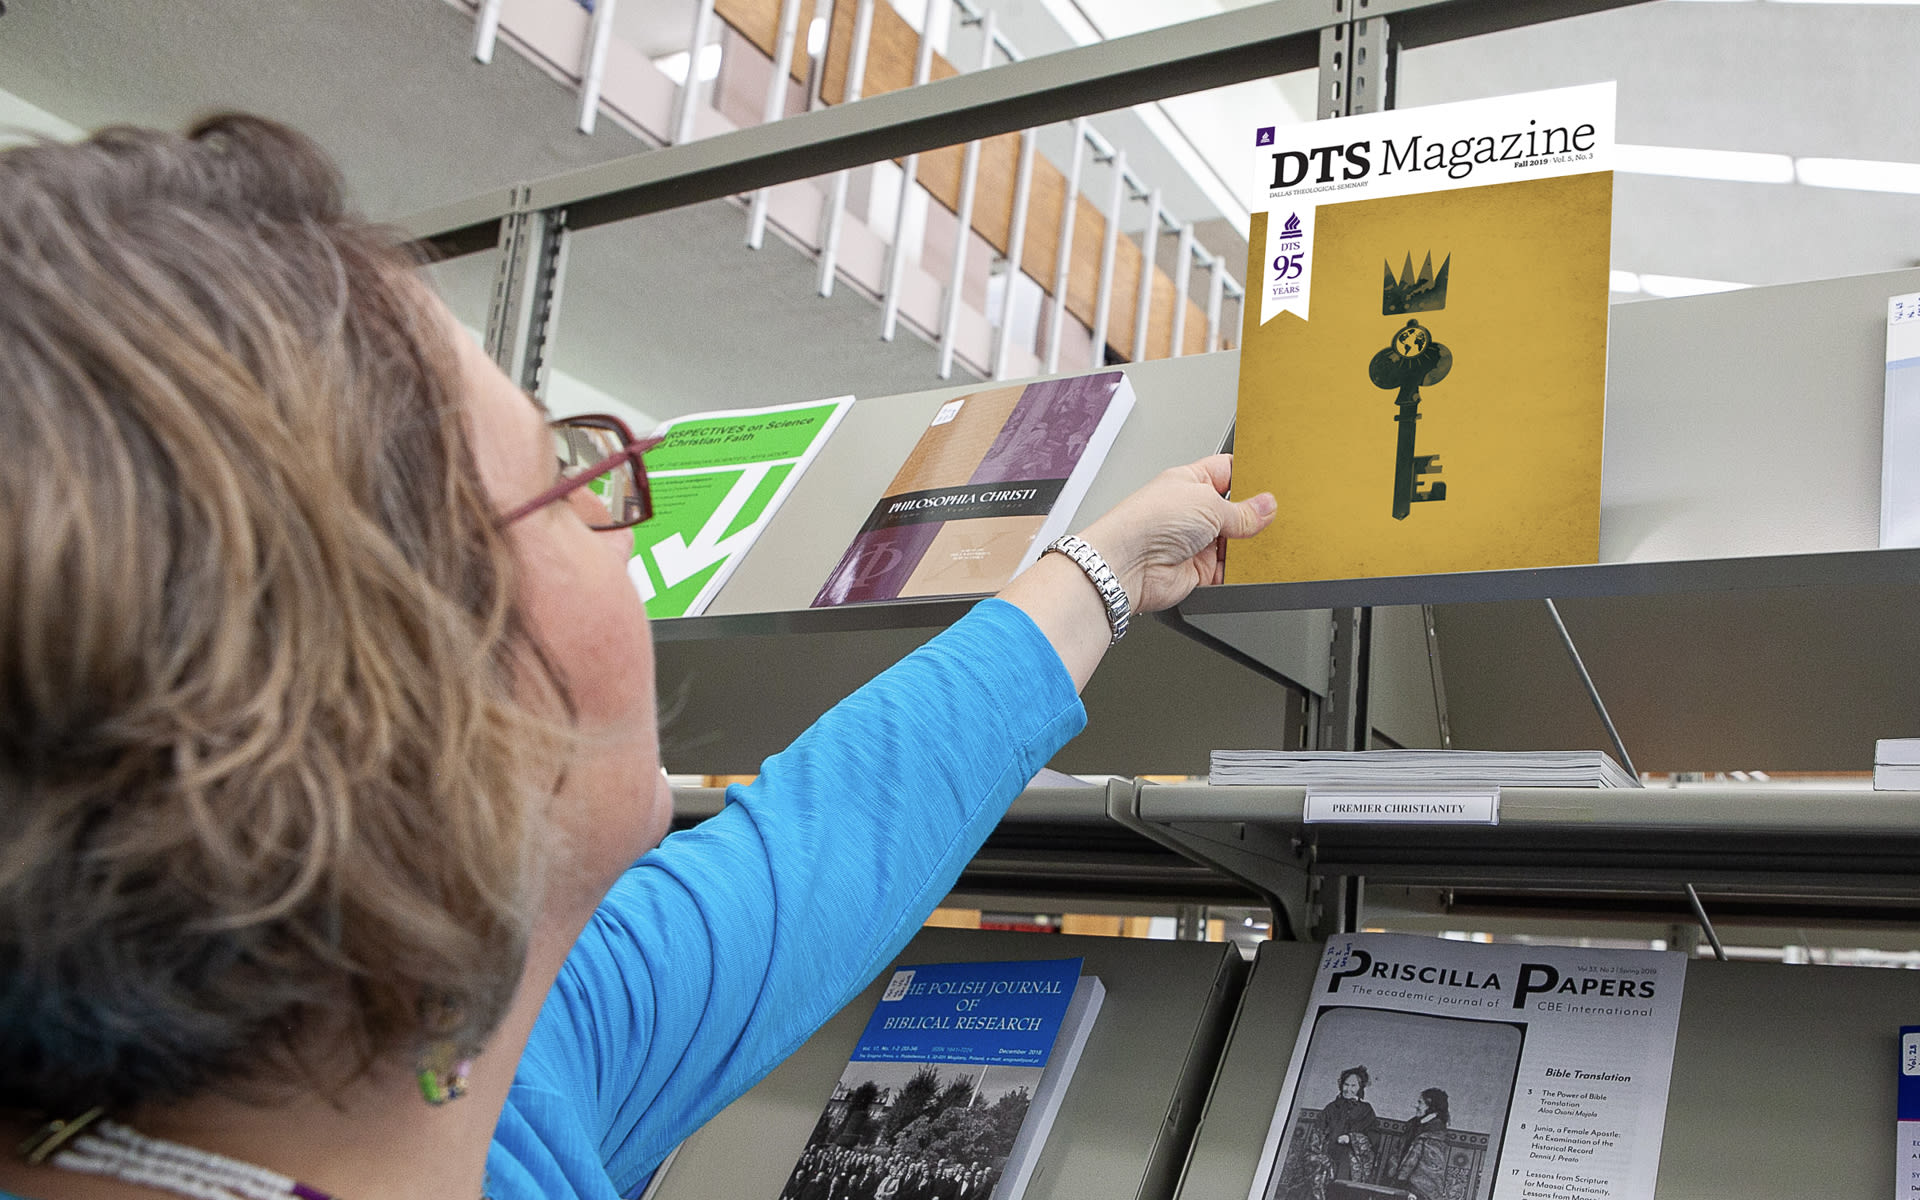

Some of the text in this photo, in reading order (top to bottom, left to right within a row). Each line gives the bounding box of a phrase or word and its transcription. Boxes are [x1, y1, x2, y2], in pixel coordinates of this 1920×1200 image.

[1269, 119, 1595, 189] DTS Magazine
[1514, 159, 1528, 168] Fall
[1529, 158, 1548, 167] 2019
[1552, 156, 1566, 164] Vol.
[1575, 153, 1587, 161] No.
[1270, 181, 1369, 198] DALLAS THEOLOGICAL SEMINARY
[1281, 242, 1300, 251] DTS
[1273, 252, 1304, 281] 95
[1272, 286, 1300, 296] YEARS
[664, 417, 815, 440] RSPECTIVES on Science
[668, 437, 721, 449] Christian
[724, 433, 755, 443] Faith
[888, 488, 1038, 514] PHILOSOPHIA CHRISTI
[1332, 803, 1465, 814] PREMIER CHRISTIANITY
[1619, 967, 1639, 975] Spring
[1327, 950, 1655, 1009] PRISCILLA PAPERS
[904, 982, 927, 995] HE
[928, 981, 984, 995] POLISH
[986, 981, 1062, 996] JOURNAL
[955, 999, 980, 1012] OF
[1352, 985, 1653, 1016] The academic journal of CBE International
[883, 1016, 1042, 1031] BIBLICAL RESEARCH
[1545, 1067, 1631, 1082] Bible Translation
[1542, 1089, 1555, 1097] The
[1556, 1090, 1579, 1099] Power
[1588, 1092, 1607, 1101] Bible
[1540, 1098, 1580, 1108] Translation
[1534, 1124, 1555, 1133] Junia,
[1563, 1126, 1589, 1135] Female
[1590, 1129, 1621, 1138] Apostle:
[1545, 1134, 1591, 1145] Examination
[1592, 1138, 1601, 1146] of
[1601, 1139, 1614, 1147] the
[1529, 1151, 1551, 1160] Dennis
[1531, 1142, 1594, 1155] Historical Record
[1511, 1168, 1609, 1186] 17 Lessons from Scripture
[1522, 1189, 1551, 1199] Lessons
[1552, 1191, 1570, 1200] from
[1524, 1179, 1611, 1196] for Maasai Christianity,
